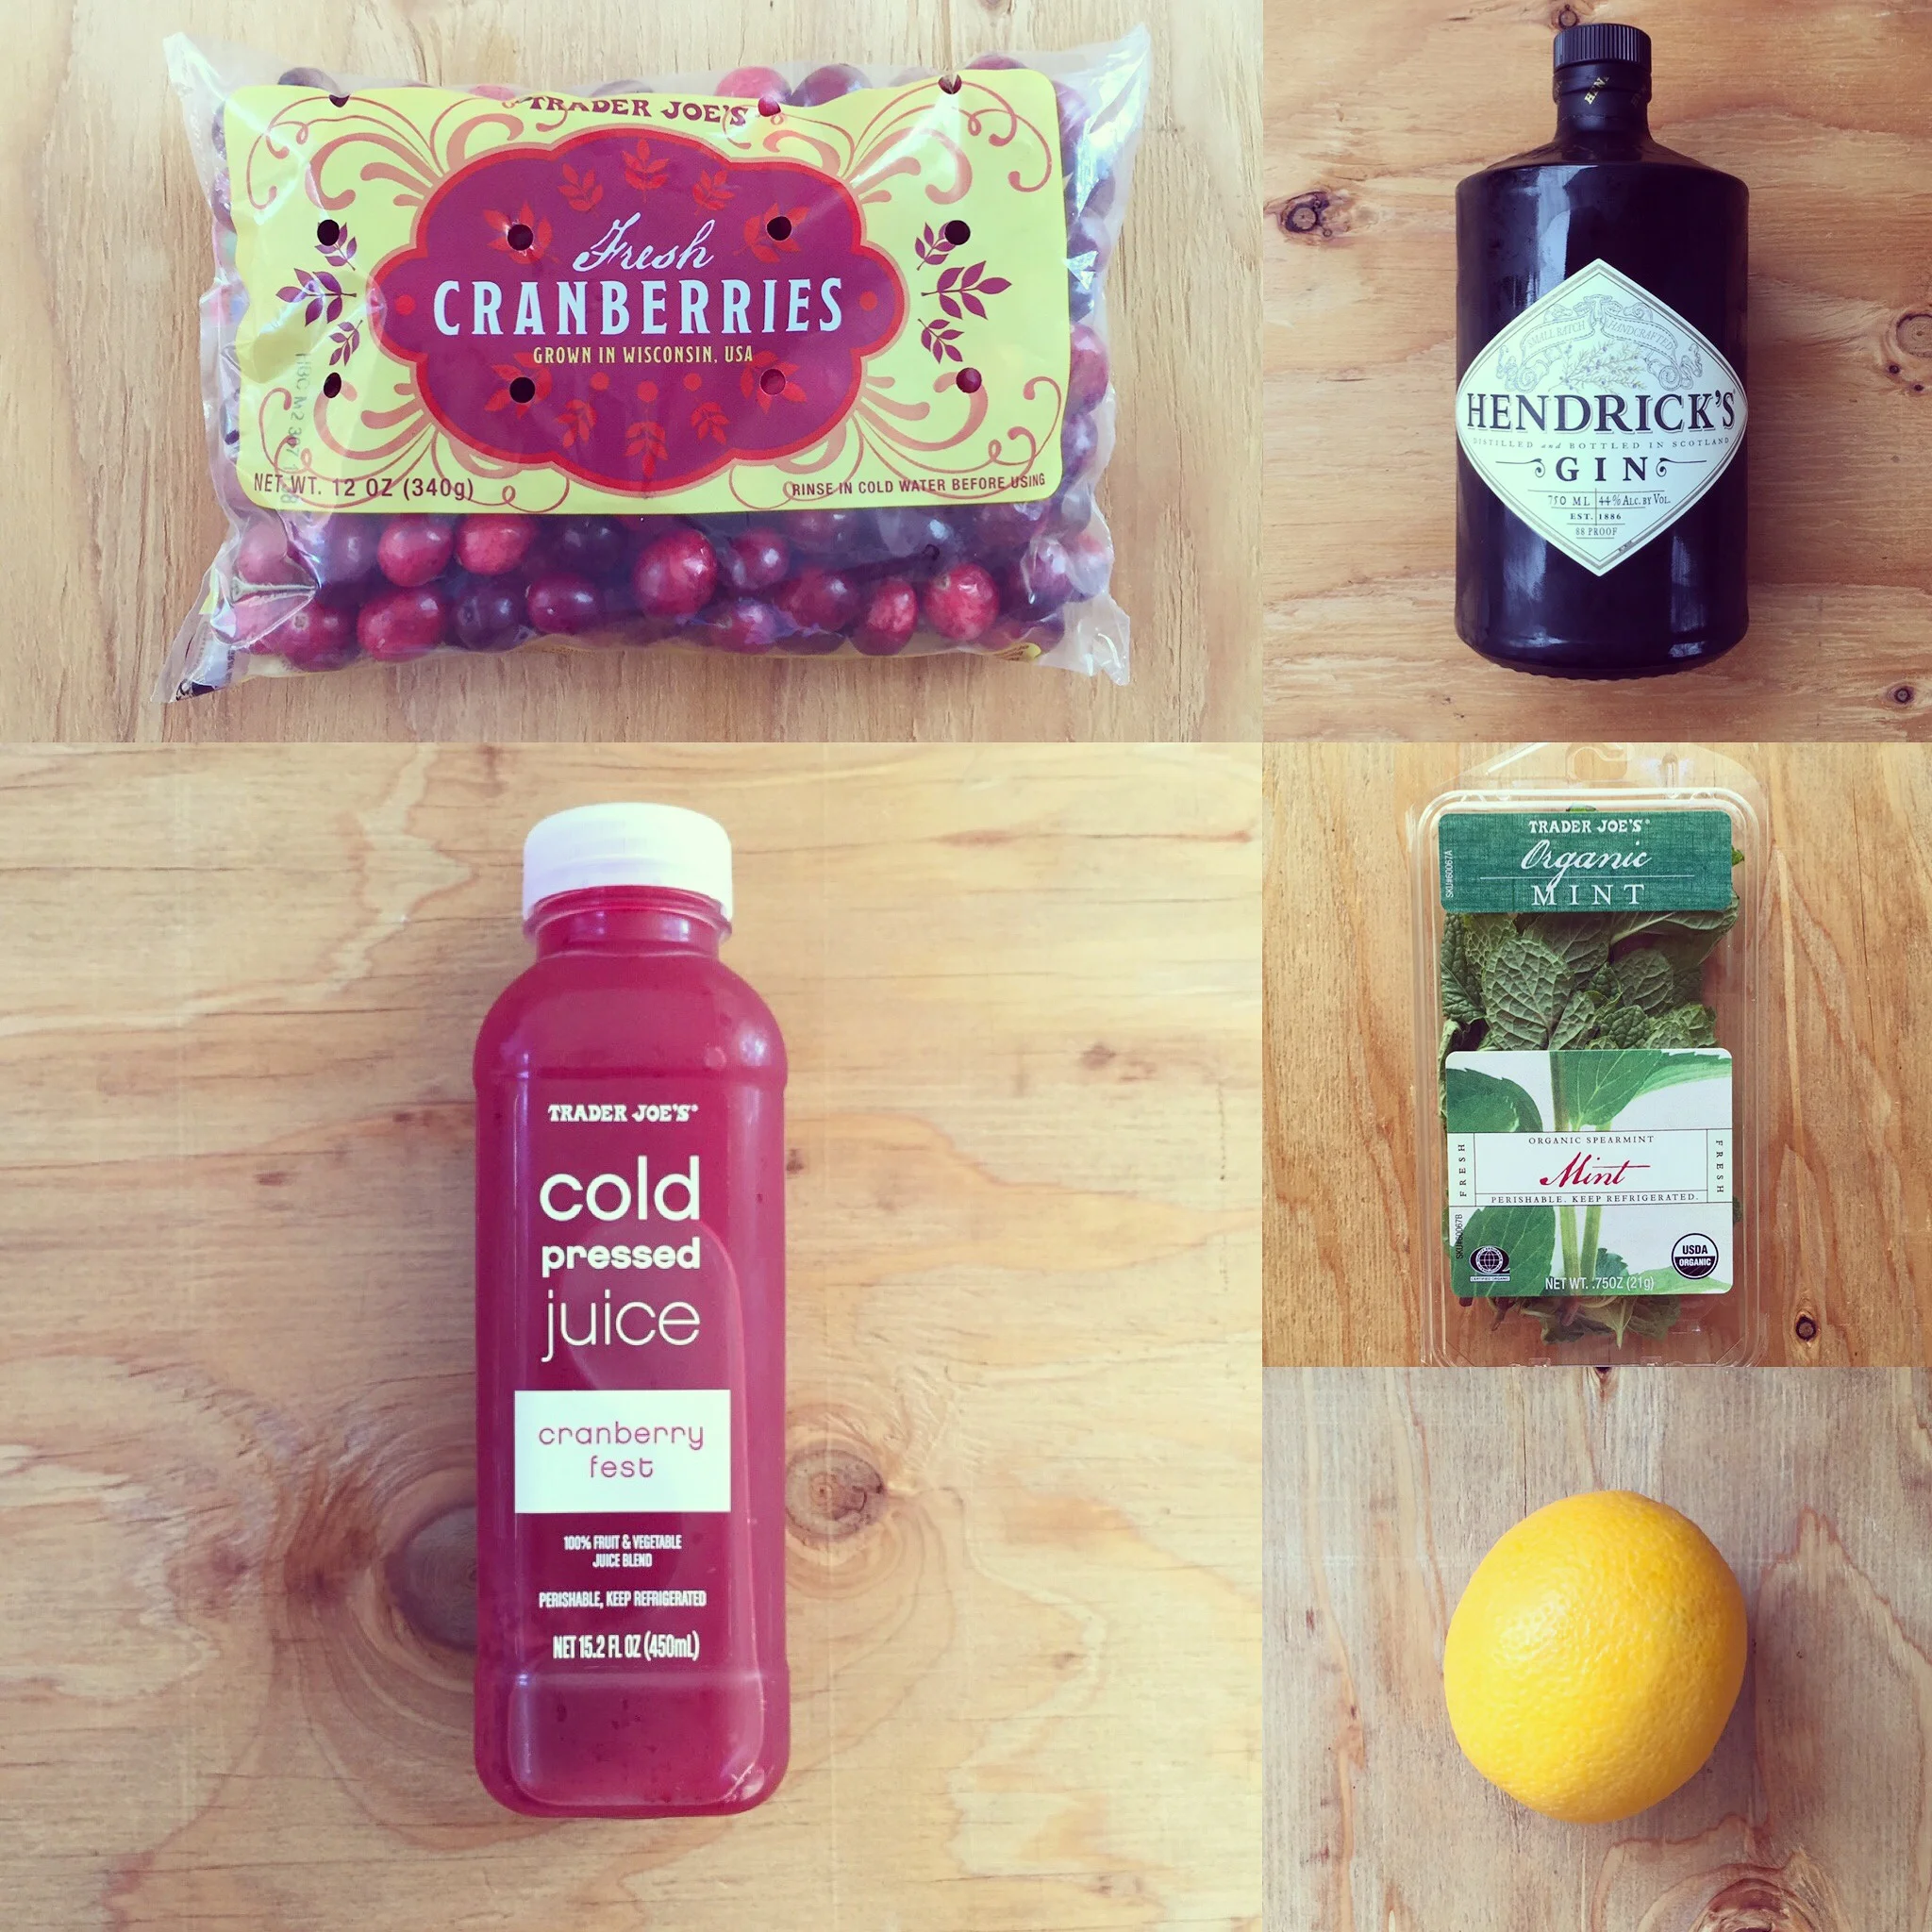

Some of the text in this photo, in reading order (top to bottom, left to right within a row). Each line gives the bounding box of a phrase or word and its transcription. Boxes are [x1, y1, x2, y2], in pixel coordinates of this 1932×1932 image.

[530, 96, 749, 126] TRADER JOE'S
[573, 212, 716, 273] Fresh
[433, 277, 842, 336] CRANBERRIES
[1606, 319, 1674, 350] HANDCRAFTED
[533, 345, 754, 364] GROWN IN WISCONSIN, USA
[1467, 390, 1737, 434] HENDRICK'S
[1473, 438, 1534, 448] DISTILLED
[1541, 441, 1561, 450] and
[1570, 441, 1641, 450] BOTTLED
[1673, 438, 1729, 448] SCOTLAND
[1556, 457, 1648, 482] GIN
[254, 473, 474, 501] NET WT. 12 OZ (340g)
[792, 473, 1045, 496] RINSE IN COLD WATER BEFORE USING
[1548, 494, 1566, 505] 750
[1573, 496, 1590, 506] ML
[1599, 494, 1621, 506] 44%
[1575, 527, 1618, 536] 88 PROOF
[1529, 820, 1642, 833] TRADER JOE'S
[1521, 840, 1652, 892] Organic
[1531, 884, 1645, 906] MINT
[548, 1103, 691, 1122] TRADER JOE'S
[1540, 1152, 1651, 1188] Mint
[540, 1155, 700, 1222] cold
[541, 1237, 700, 1277] pressed
[1682, 1244, 1708, 1255] USDA
[1679, 1257, 1711, 1266] ORGANIC
[1545, 1275, 1655, 1291] NET WT. .75OZ (21g)
[541, 1289, 700, 1362] juice
[539, 1422, 704, 1451] cranberry
[590, 1456, 654, 1478] fest
[563, 1535, 682, 1550] 100% FRUIT & VEGETABLE
[592, 1554, 652, 1567] JUICE BLEND
[539, 1591, 707, 1609] PERISHABLE, KEEP REFRIGERATED
[553, 1630, 700, 1661] NET 15.2 FL OZ (450mL)
